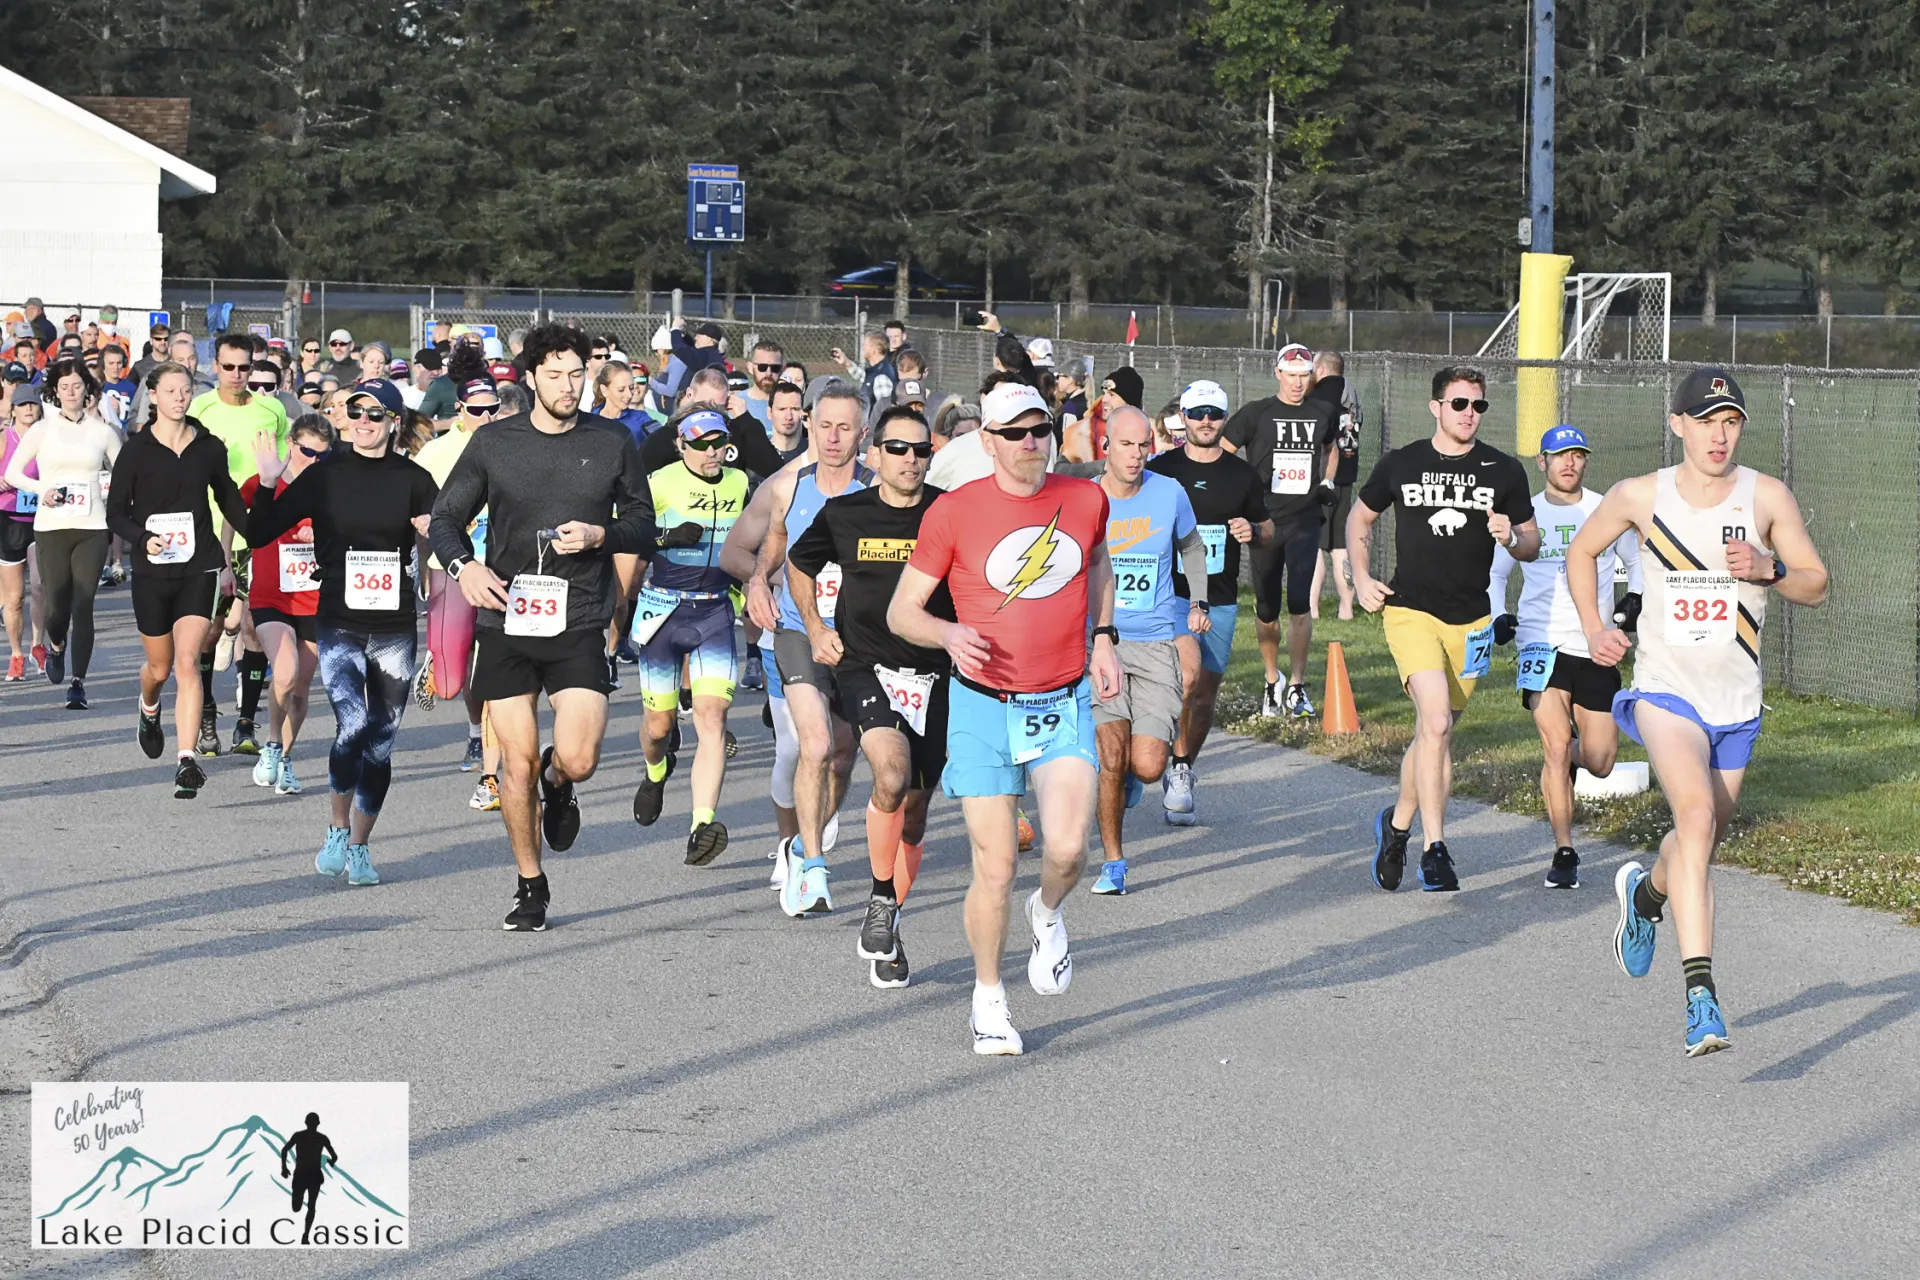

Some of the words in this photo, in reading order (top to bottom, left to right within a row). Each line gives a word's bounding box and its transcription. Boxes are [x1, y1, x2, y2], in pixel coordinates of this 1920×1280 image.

[1276, 422, 1316, 442] FLY
[1556, 429, 1584, 444] RTA
[1278, 469, 1306, 480] 508
[1422, 472, 1476, 486] BUFFALO
[65, 494, 85, 505] 32
[1401, 483, 1494, 510] BILLS
[1108, 516, 1151, 540] RUN
[160, 532, 188, 546] 73
[860, 550, 895, 559] Placid
[286, 561, 316, 575] 493
[354, 573, 392, 590] 368
[543, 580, 566, 588] CLASSIC
[1114, 574, 1150, 591] 126
[1683, 576, 1706, 584] PLACID
[515, 598, 558, 616] 353
[1674, 599, 1728, 621] 382
[1026, 697, 1048, 706] PLACID
[1025, 714, 1061, 737] 59
